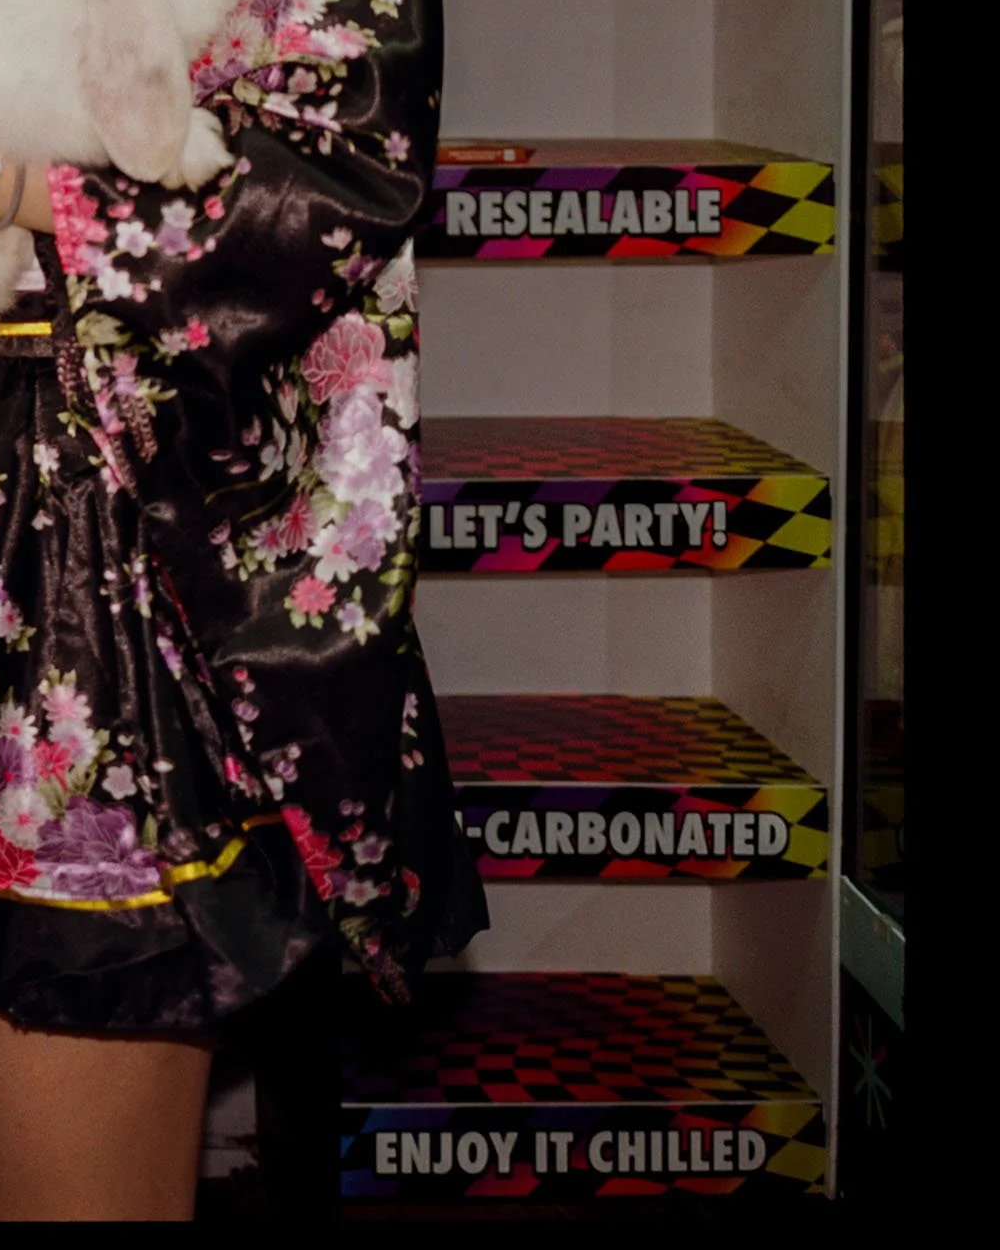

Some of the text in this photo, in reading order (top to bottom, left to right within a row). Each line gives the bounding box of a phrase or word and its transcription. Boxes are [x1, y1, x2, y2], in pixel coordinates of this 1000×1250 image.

[445, 189, 723, 236] RESEALABLE
[429, 501, 729, 549] LET'S PARTY!
[375, 1130, 768, 1176] ENJOY IT CHILLED
